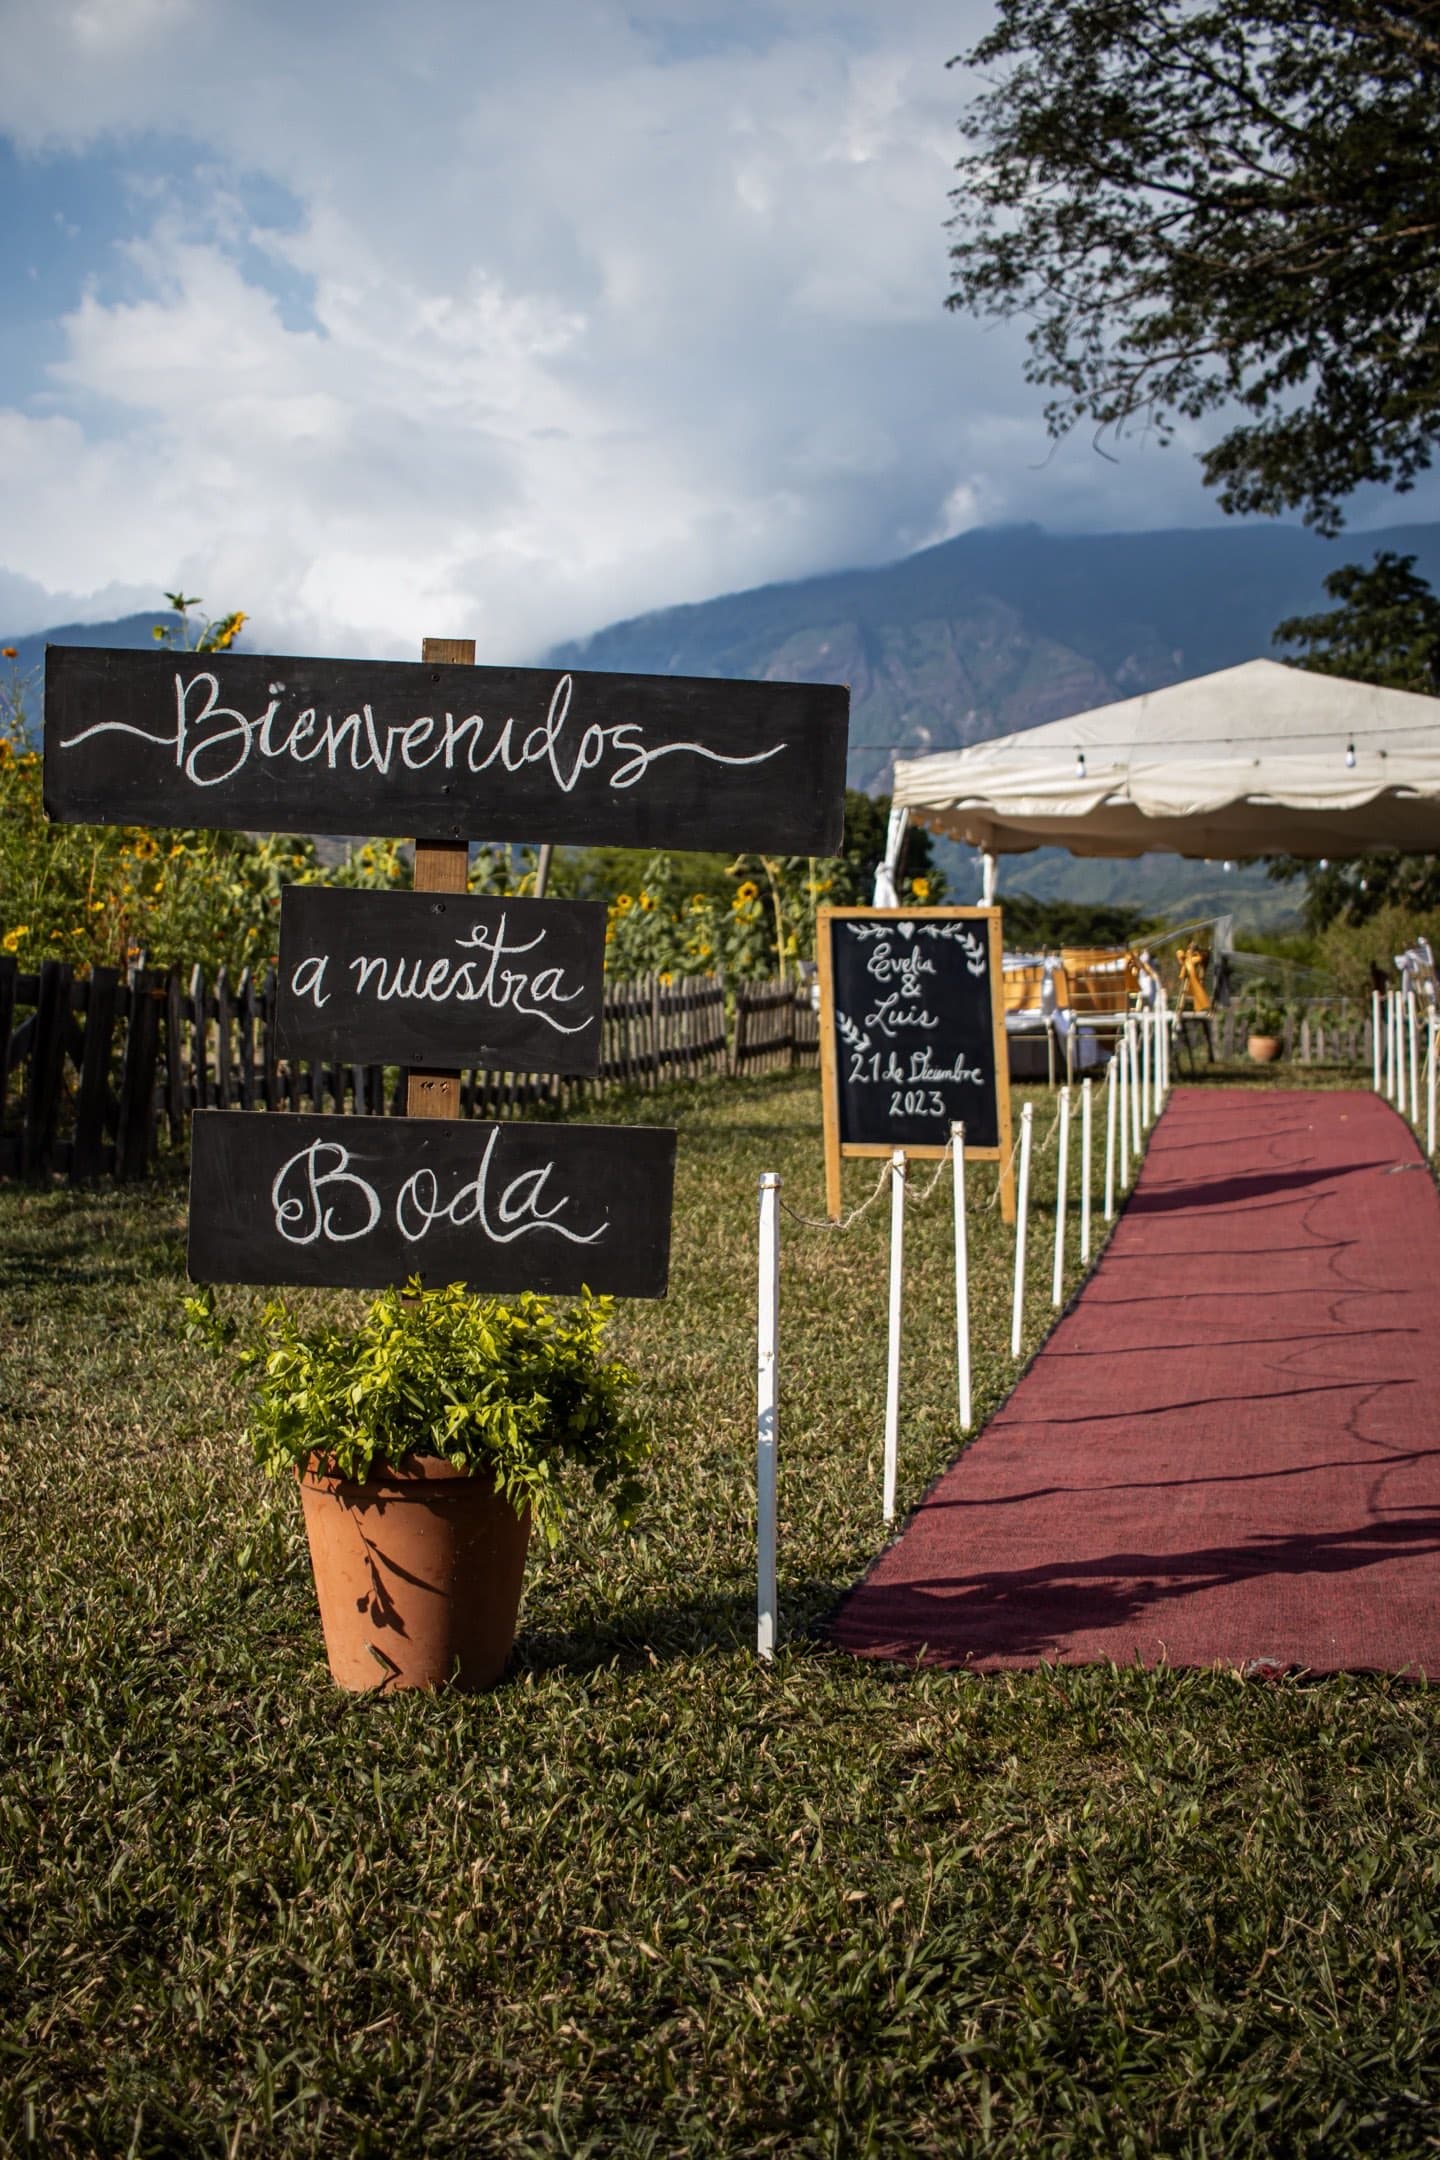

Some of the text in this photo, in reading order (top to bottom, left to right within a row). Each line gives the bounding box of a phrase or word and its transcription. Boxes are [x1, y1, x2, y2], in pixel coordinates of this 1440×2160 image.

[60, 673, 788, 792] Bienvenidos
[291, 912, 593, 1034] a nuestra
[867, 942, 937, 982] Evelia
[901, 974, 922, 997] &
[864, 991, 939, 1037] Luis
[848, 1052, 881, 1083] 21
[881, 1051, 904, 1085] de
[888, 1089, 946, 1117] 2023
[272, 1126, 609, 1244] Boda
